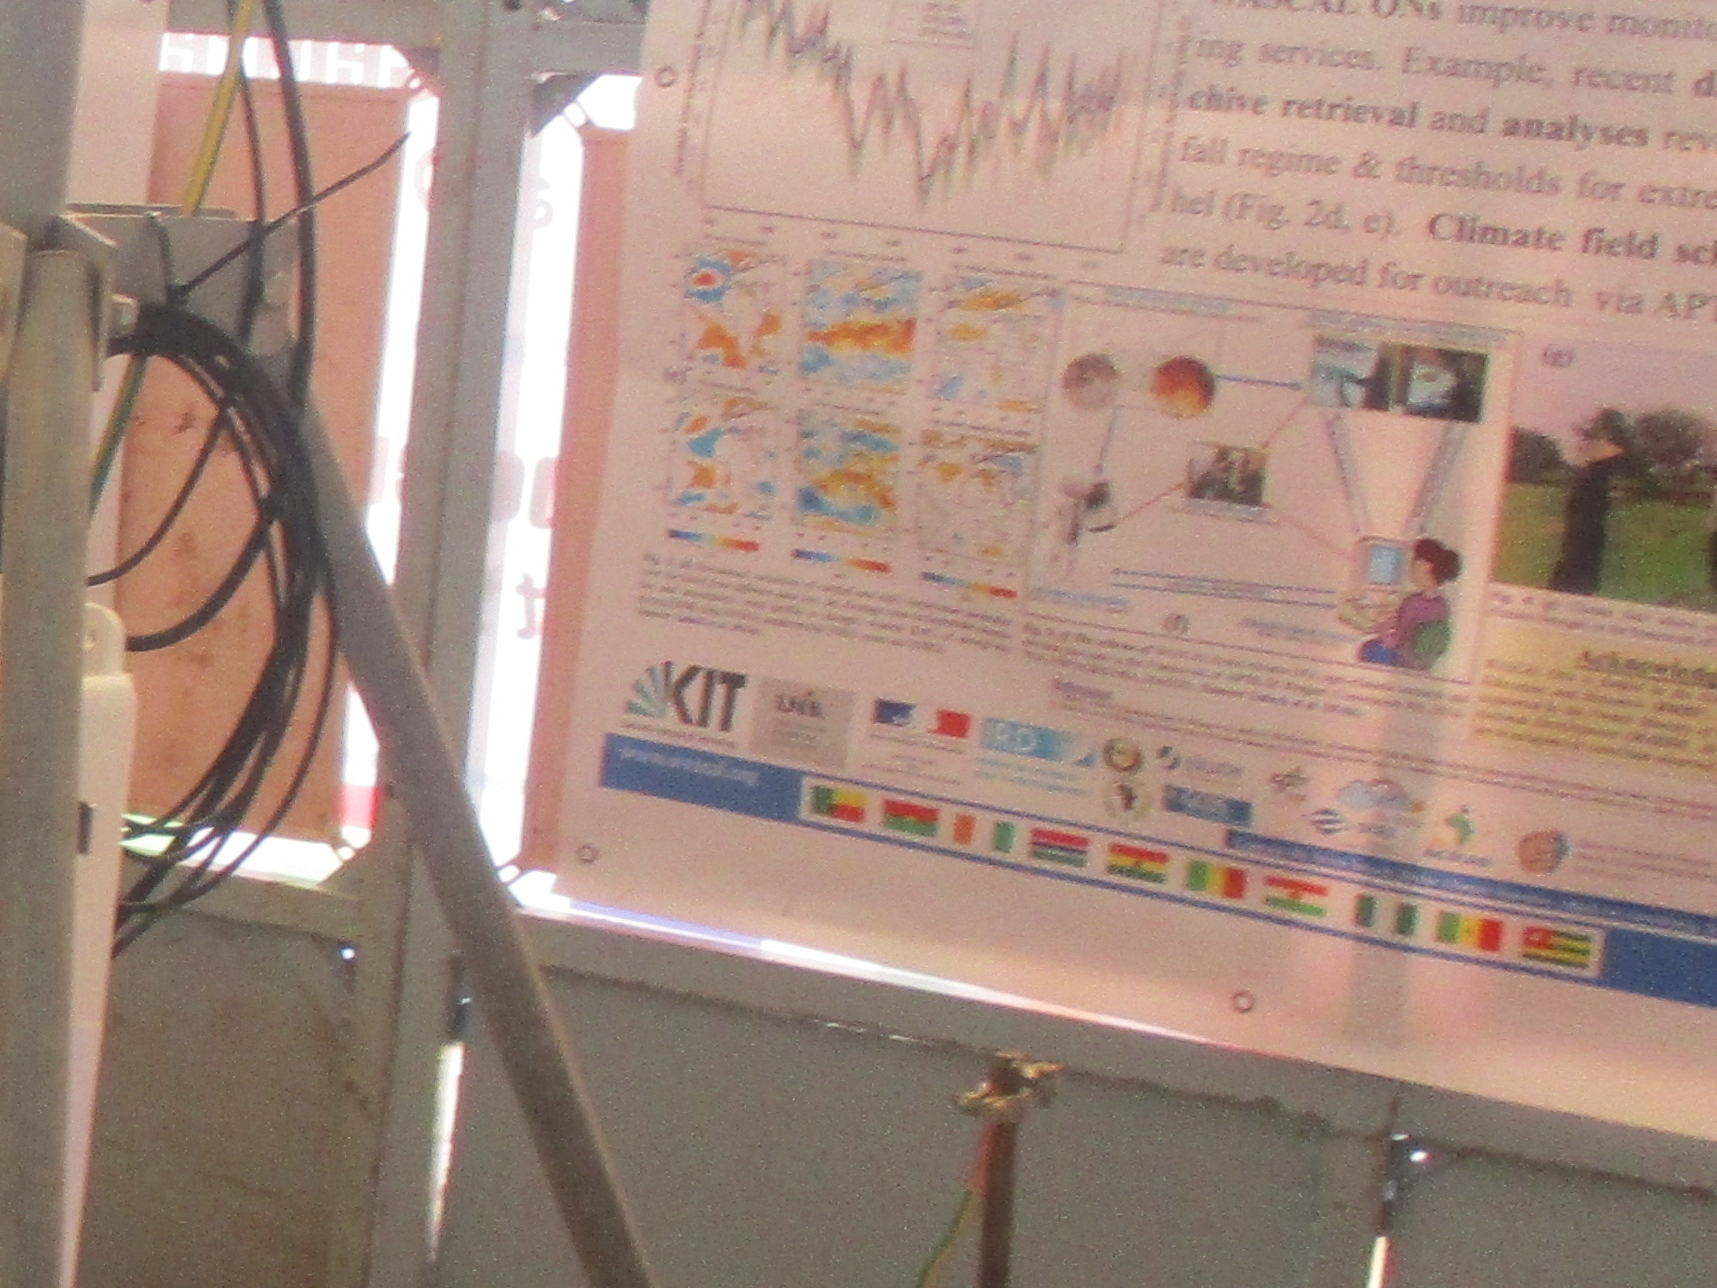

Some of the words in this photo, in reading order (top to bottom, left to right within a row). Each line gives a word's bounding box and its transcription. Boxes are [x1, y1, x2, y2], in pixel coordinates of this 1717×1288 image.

[1194, 30, 1244, 65] ing
[1401, 44, 1554, 90] Example,
[1569, 60, 1676, 97] recent
[1186, 83, 1268, 118] chive
[1281, 90, 1419, 132] retrieval
[1430, 104, 1487, 136] and
[1501, 110, 1649, 152] analyses
[1179, 133, 1227, 168] fall
[1237, 141, 1342, 180] regime
[1352, 151, 1381, 181] &
[1395, 154, 1561, 197] thresholds
[1577, 169, 1625, 202] for
[1170, 185, 1214, 217] hel
[1303, 199, 1352, 234] 2d,
[1426, 209, 1564, 253] Climate
[1581, 224, 1658, 261] field
[1160, 240, 1207, 270] are
[1213, 242, 1369, 289] developed
[1378, 259, 1424, 292] for
[1432, 271, 1573, 310] outreach
[1595, 285, 1643, 317] via
[662, 660, 749, 732] KIT
